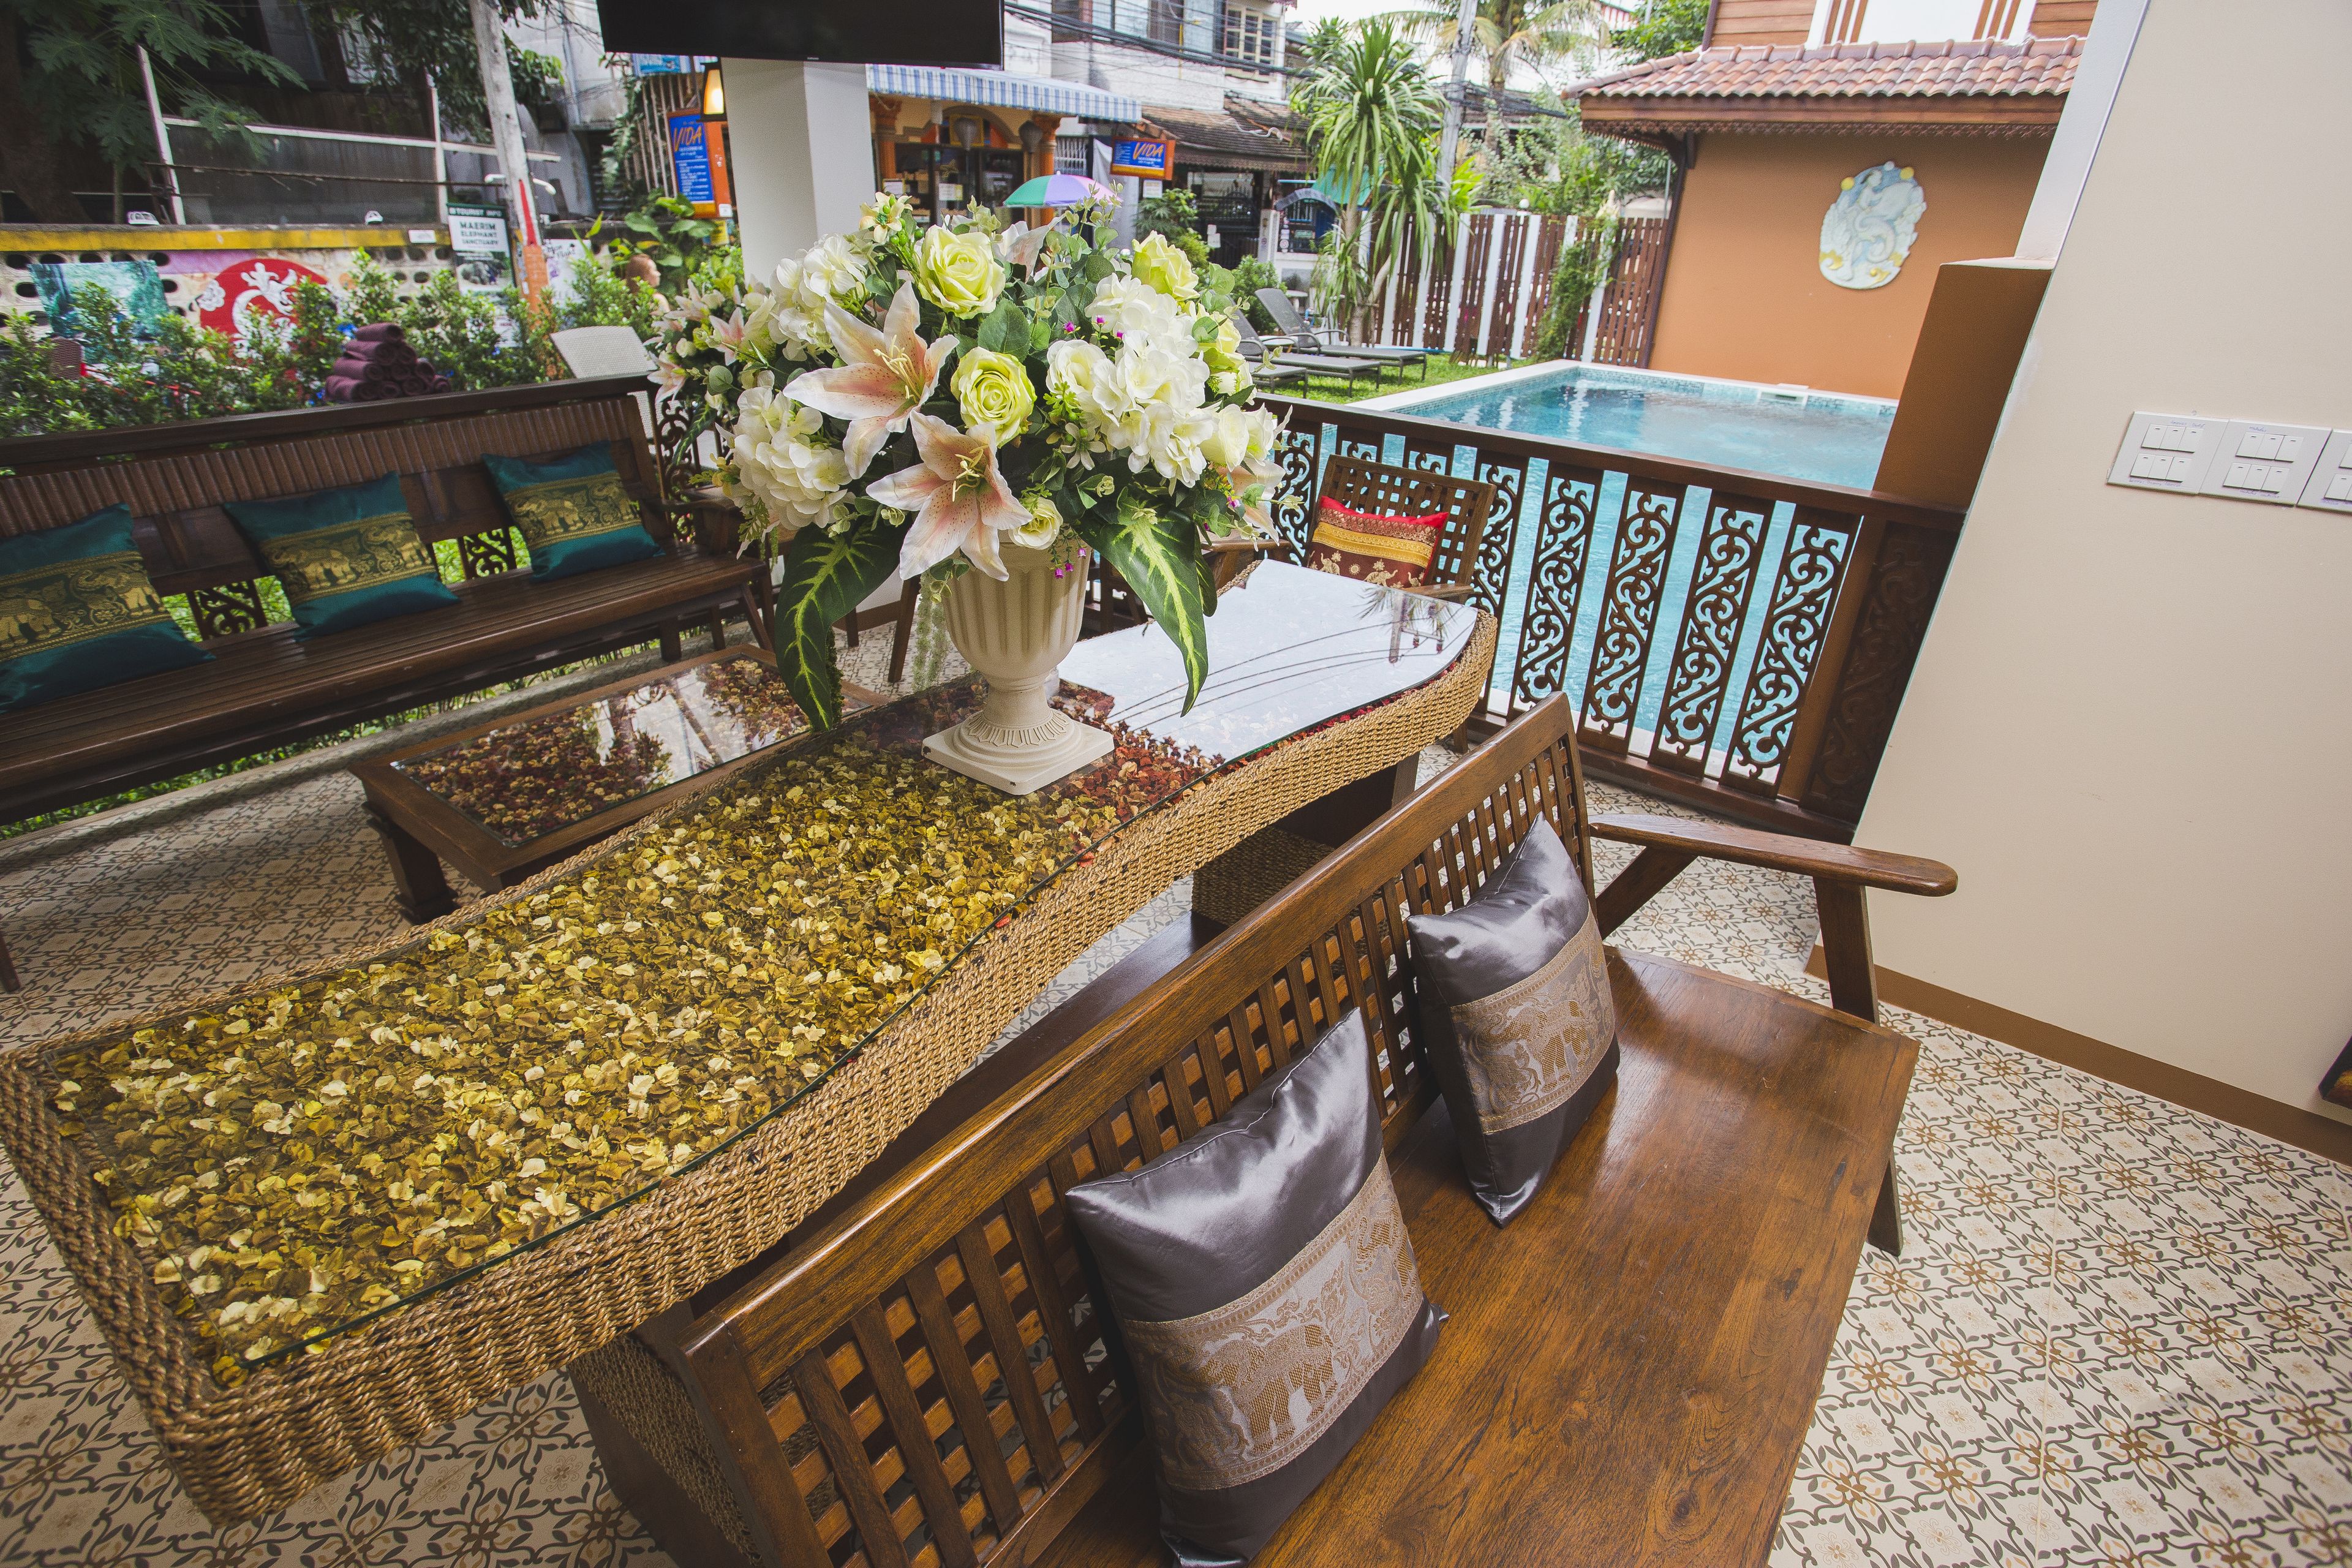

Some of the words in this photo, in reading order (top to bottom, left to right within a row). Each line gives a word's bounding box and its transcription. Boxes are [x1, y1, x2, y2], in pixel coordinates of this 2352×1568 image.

[674, 126, 702, 151] VIDA
[1133, 141, 1164, 160] VIDA
[459, 221, 496, 230] MAERIM
